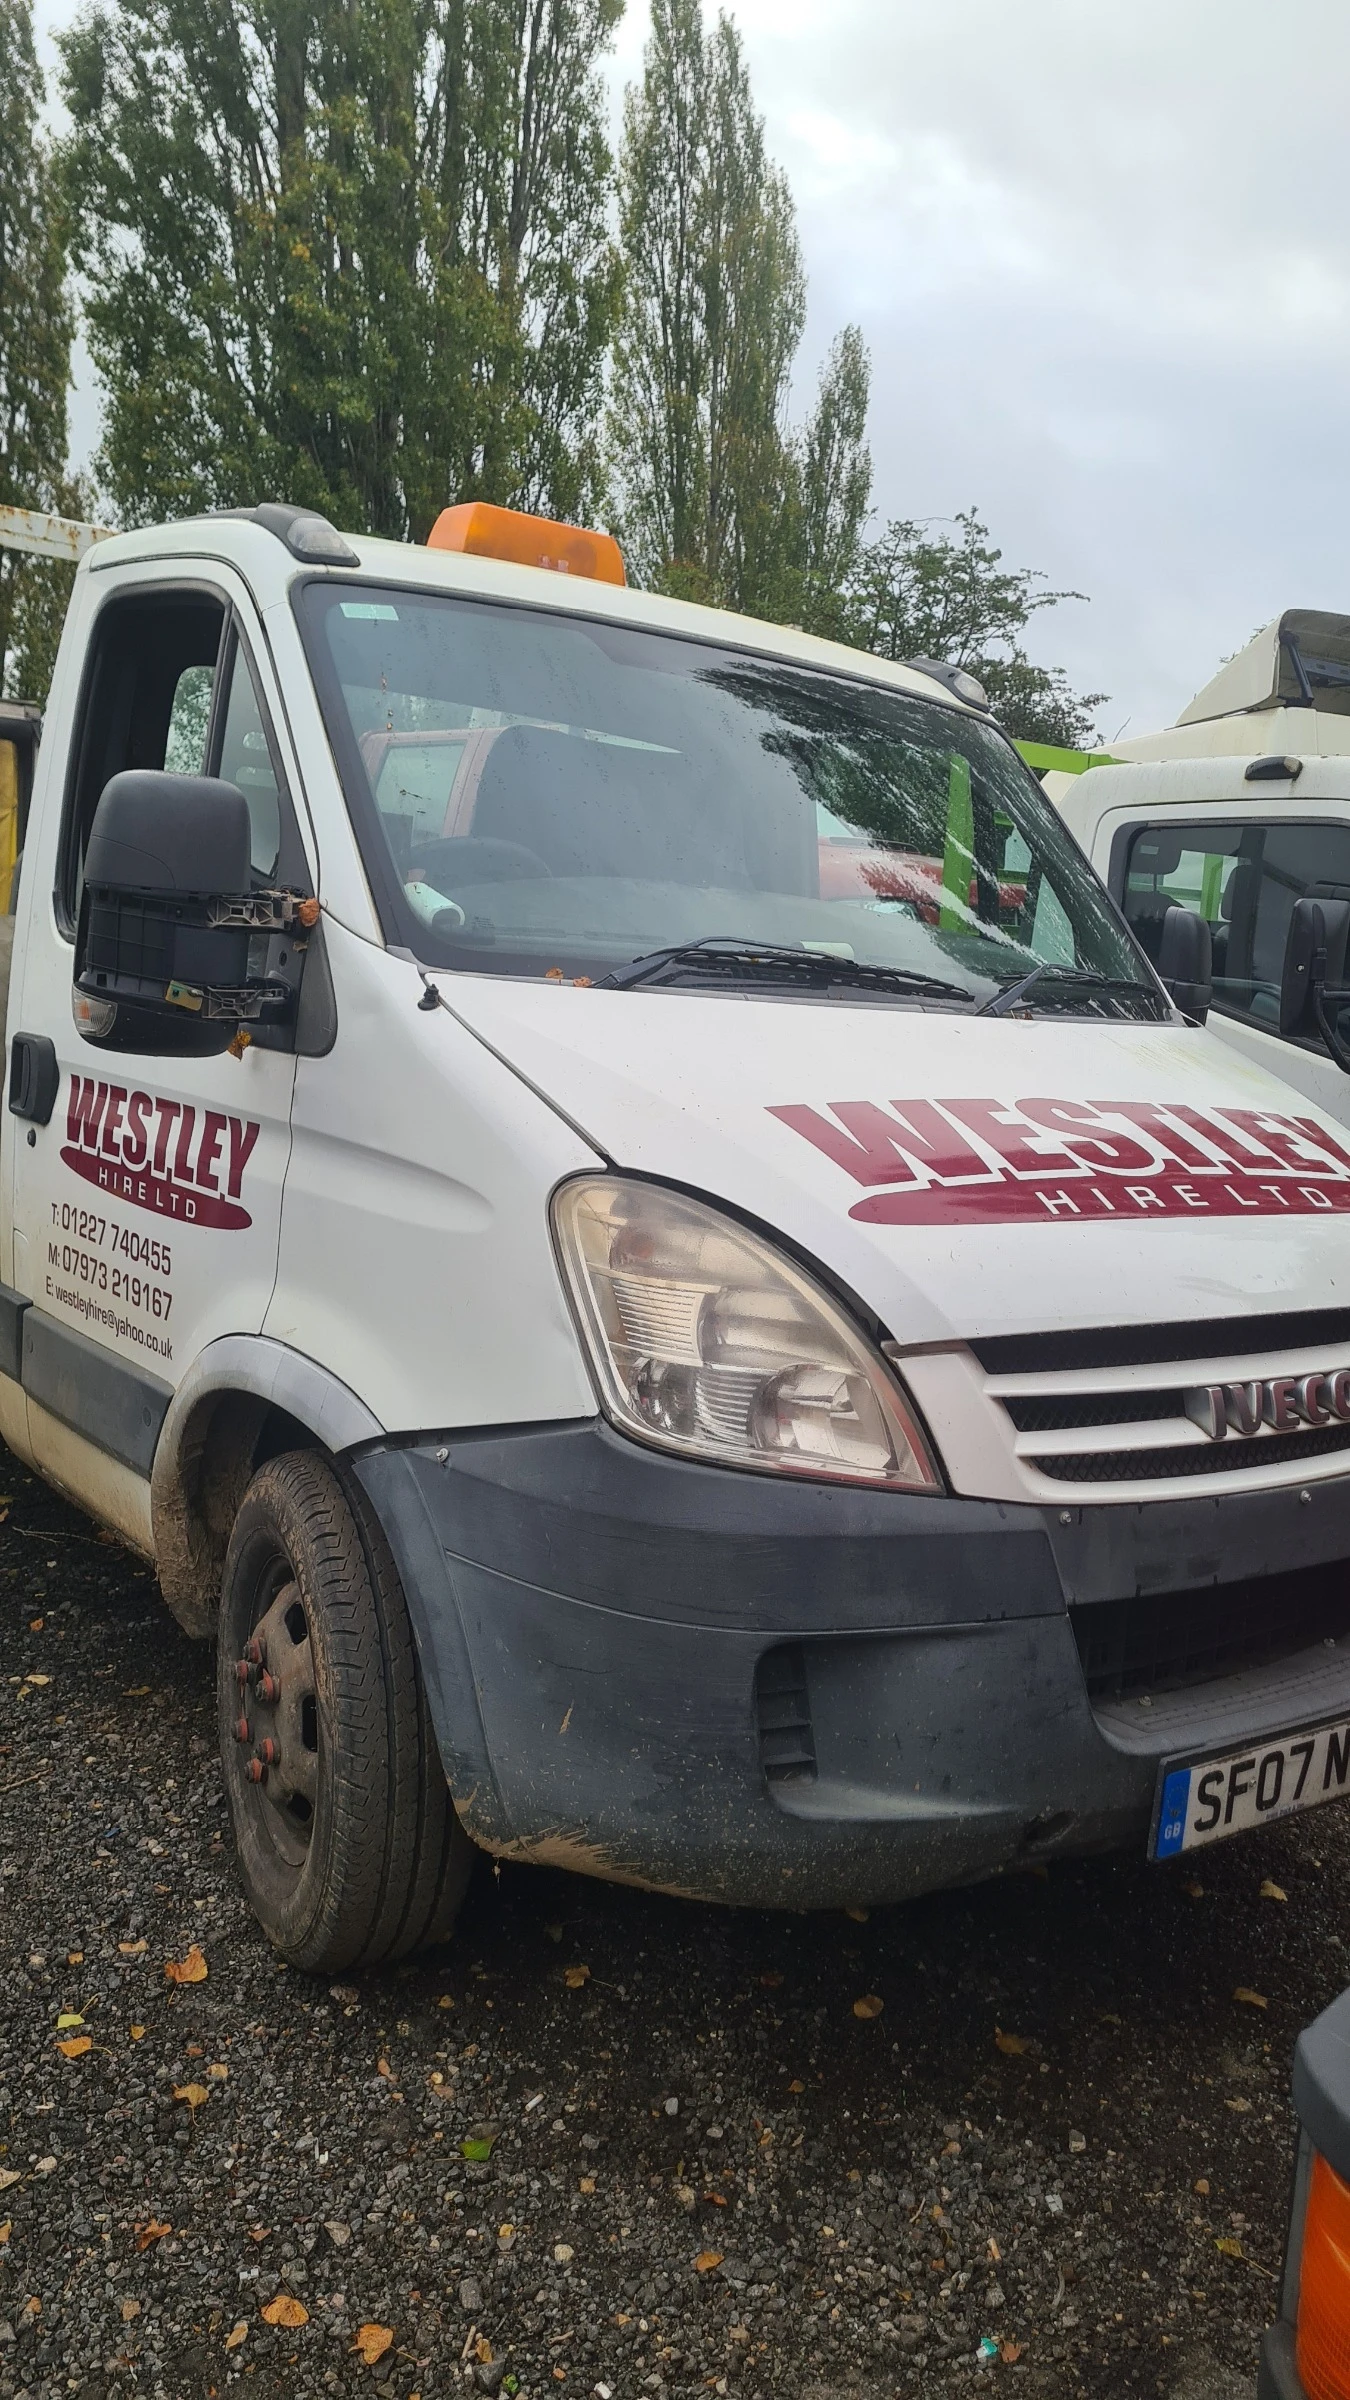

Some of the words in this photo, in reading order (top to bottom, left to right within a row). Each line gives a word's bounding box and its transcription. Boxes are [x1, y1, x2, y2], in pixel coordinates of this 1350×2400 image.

[66, 1073, 261, 1200] WESTLEY
[99, 1166, 147, 1201] HIRE
[156, 1187, 197, 1219] LTD
[1034, 1184, 1210, 1215] HIRE
[1223, 1184, 1333, 1208] LTD
[111, 1223, 171, 1276] 740455
[112, 1268, 173, 1322] 219167
[55, 1284, 173, 1361] westleyhire@yahoo.co.uk
[1200, 1369, 1350, 1440] IVECO
[1193, 1738, 1316, 1833] SF07
[1164, 1822, 1181, 1840] GB
